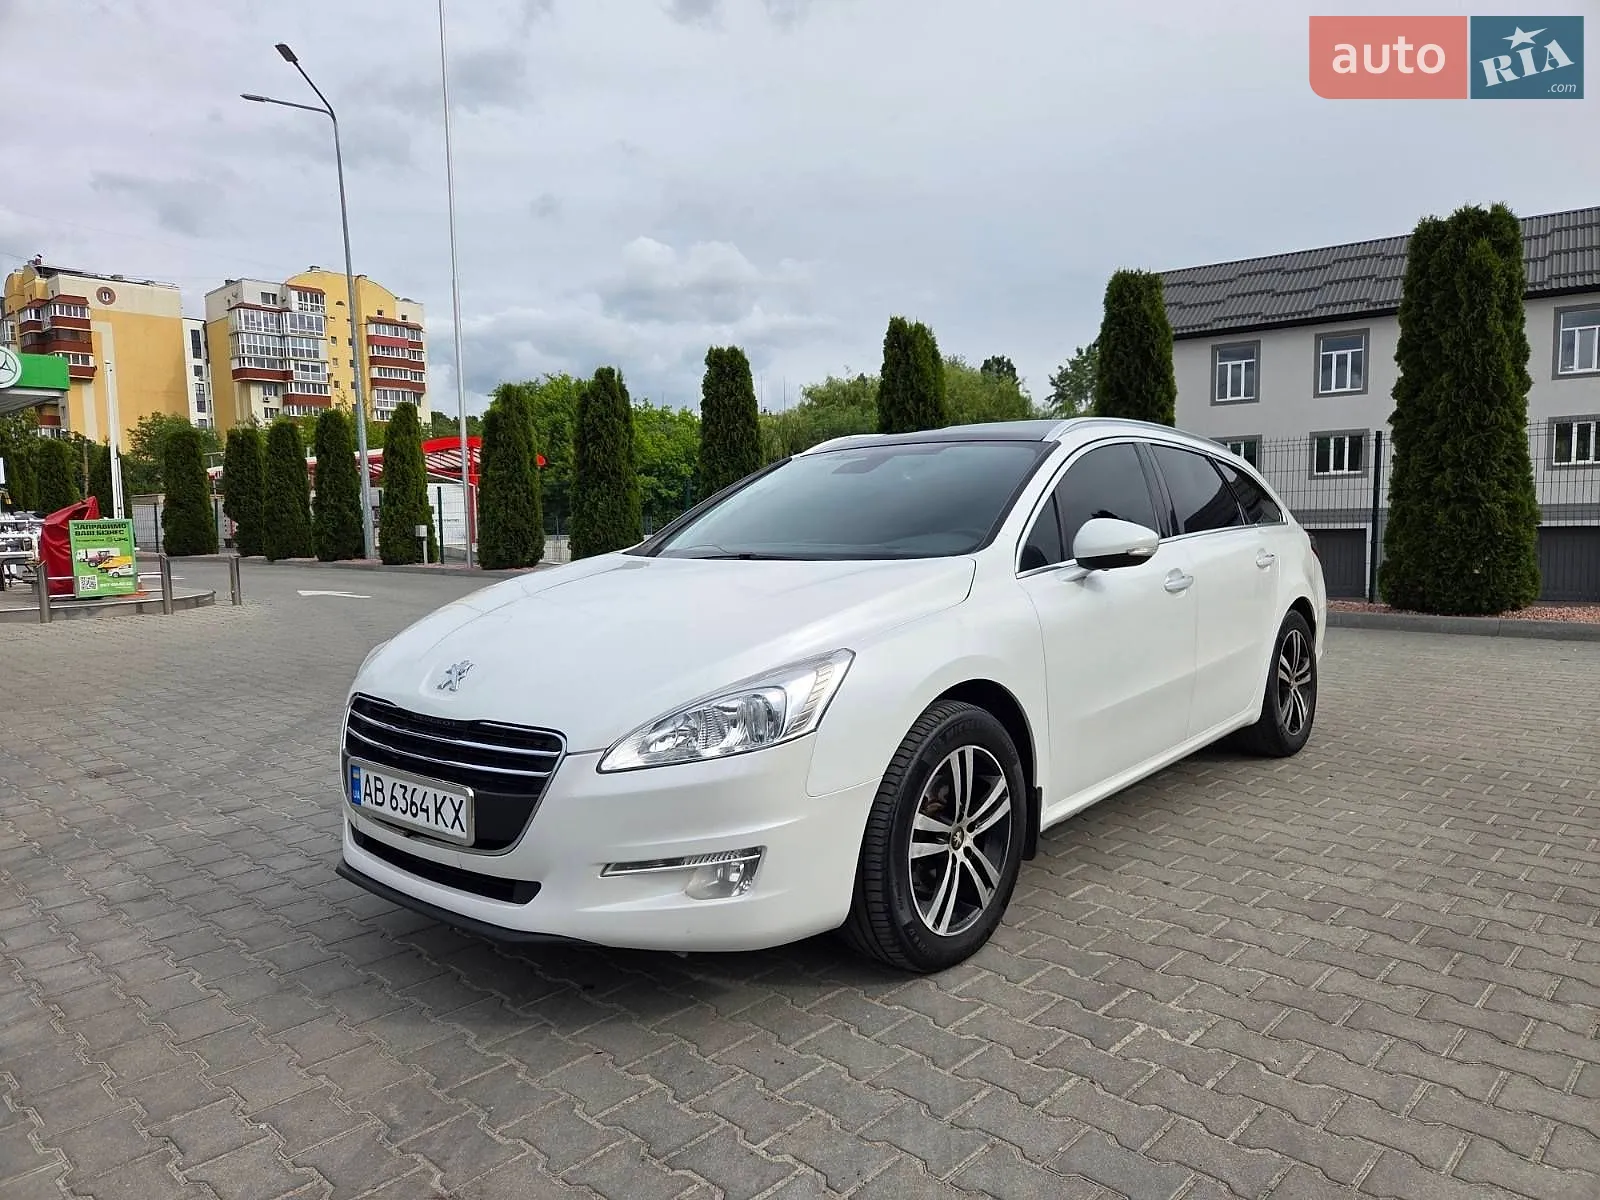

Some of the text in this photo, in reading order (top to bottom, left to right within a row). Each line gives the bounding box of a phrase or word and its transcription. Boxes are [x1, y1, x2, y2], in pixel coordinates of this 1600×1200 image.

[363, 773, 466, 833] AB 6364 KX
